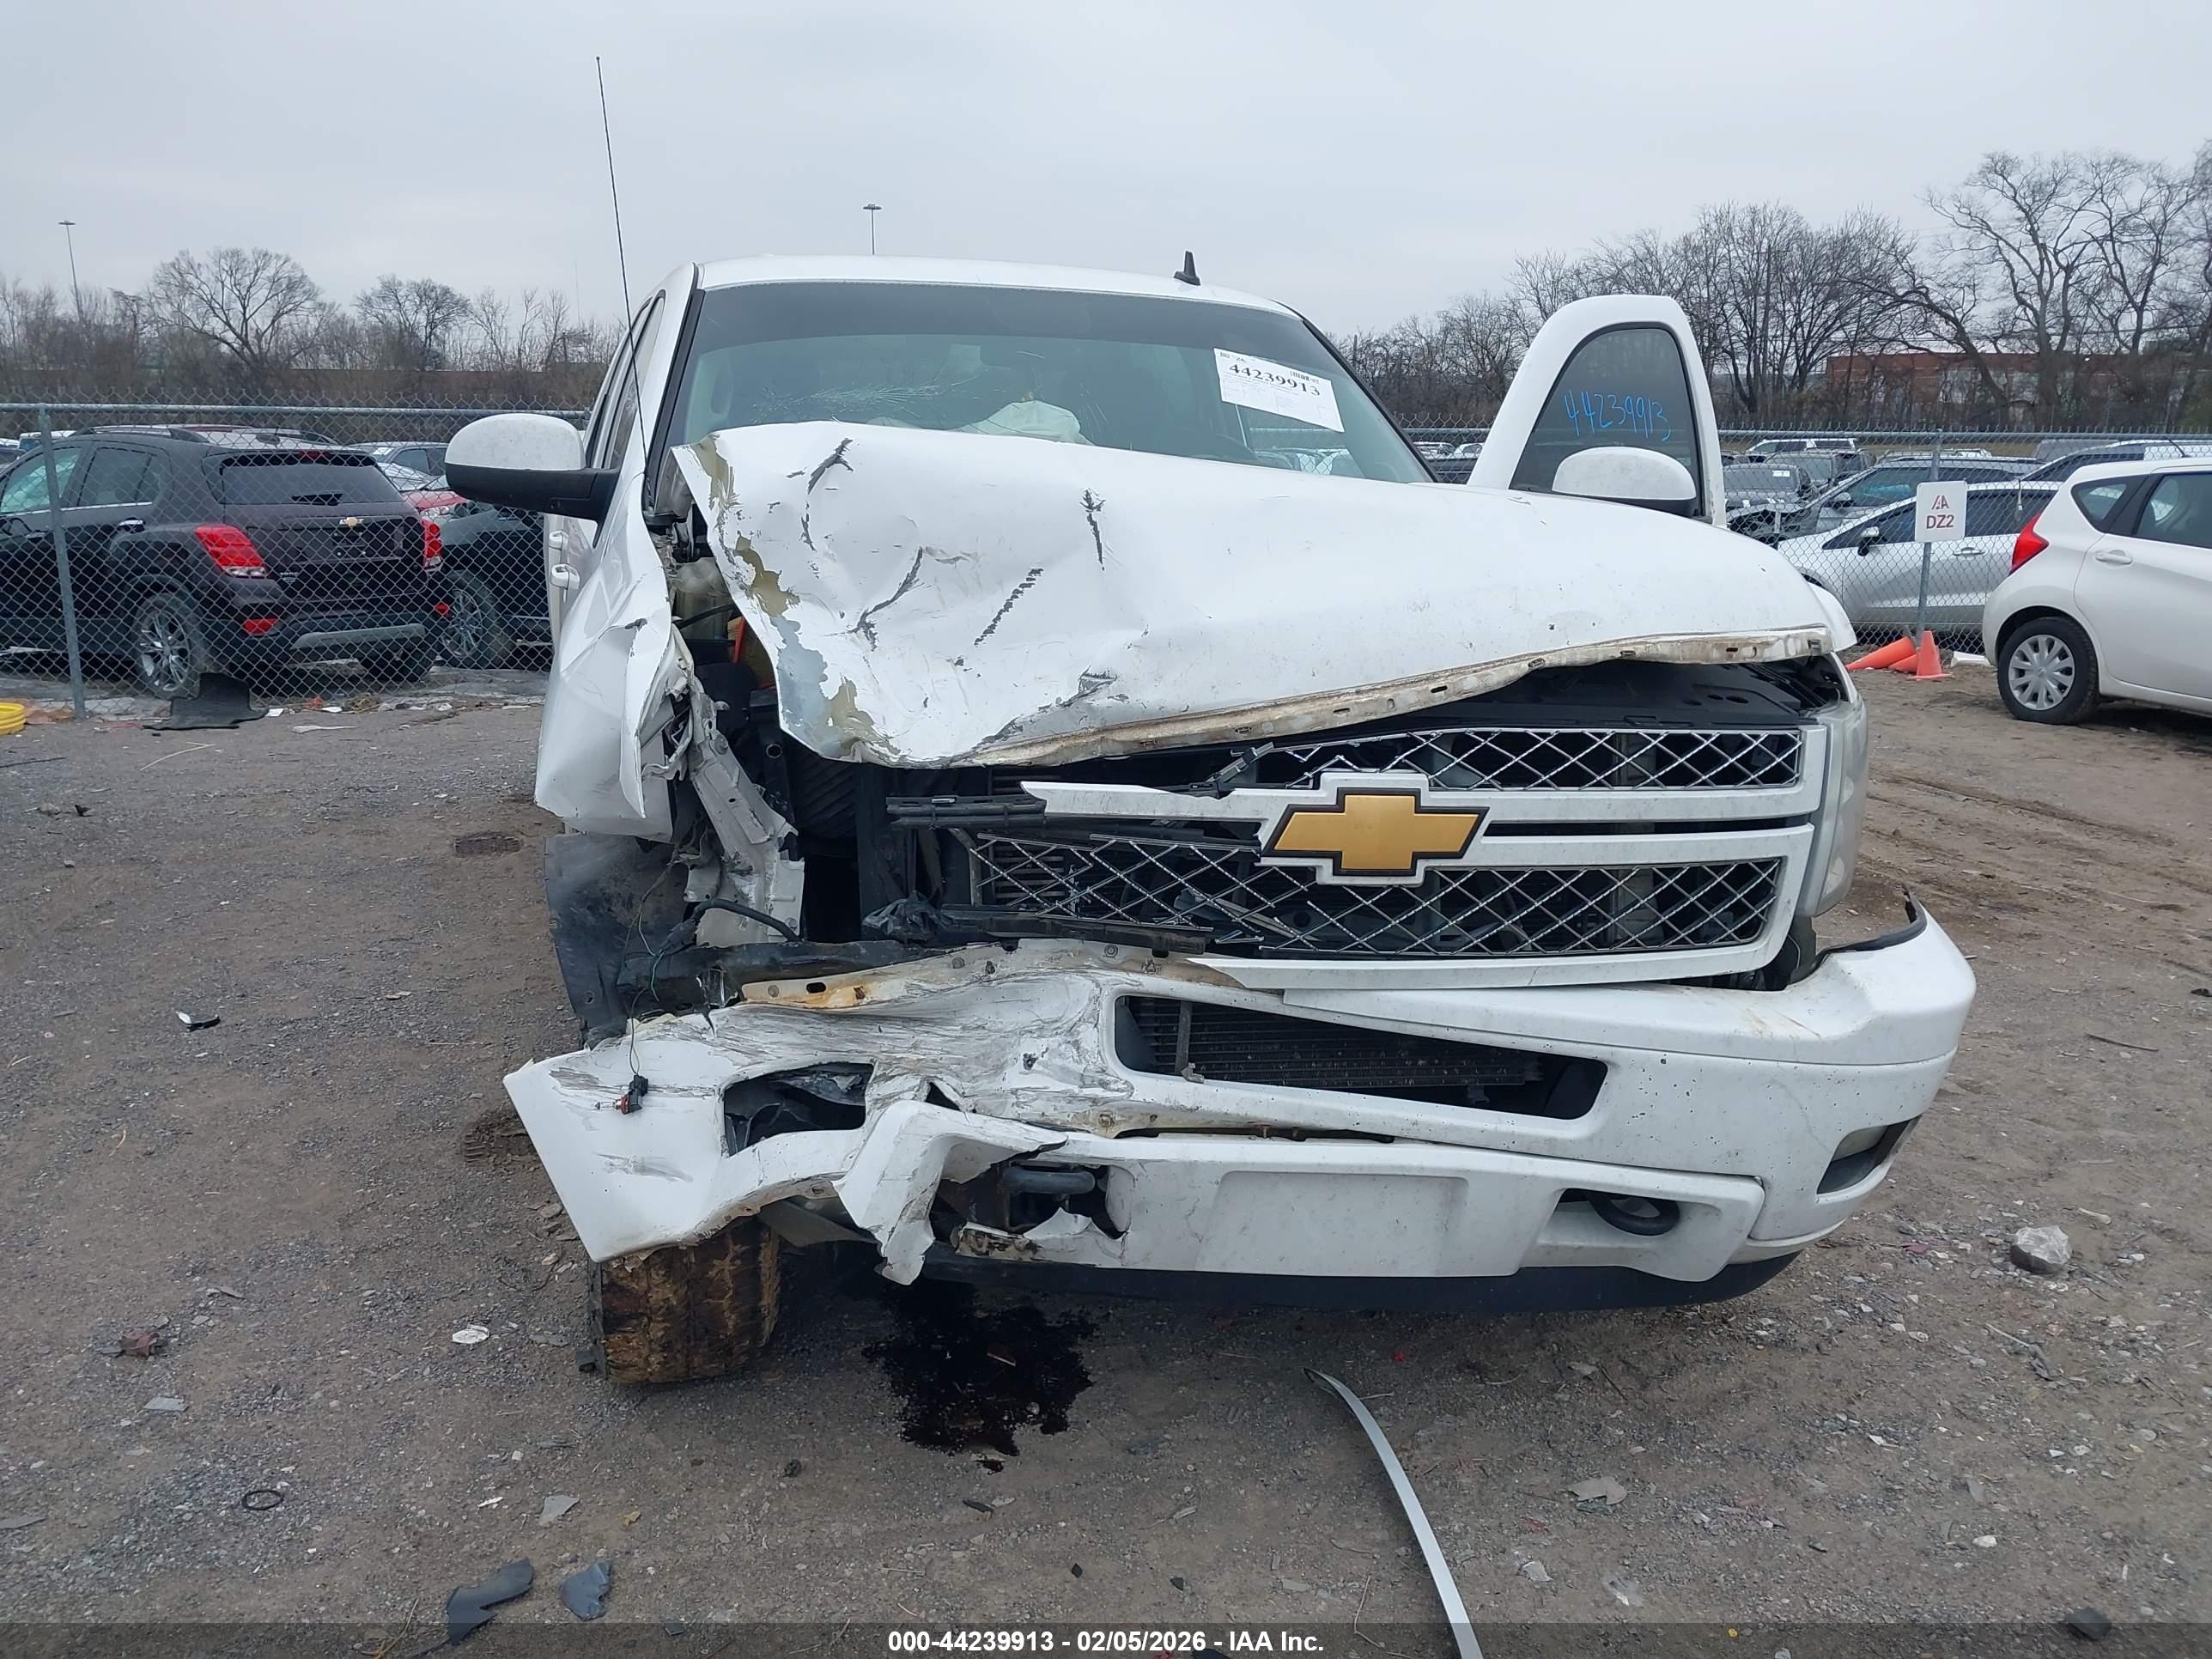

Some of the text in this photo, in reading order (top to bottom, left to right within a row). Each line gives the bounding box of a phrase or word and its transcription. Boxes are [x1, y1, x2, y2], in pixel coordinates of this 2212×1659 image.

[1229, 363, 1321, 397] 44239913
[1564, 389, 1671, 441] 44239913
[1926, 514, 1955, 530] DZ2
